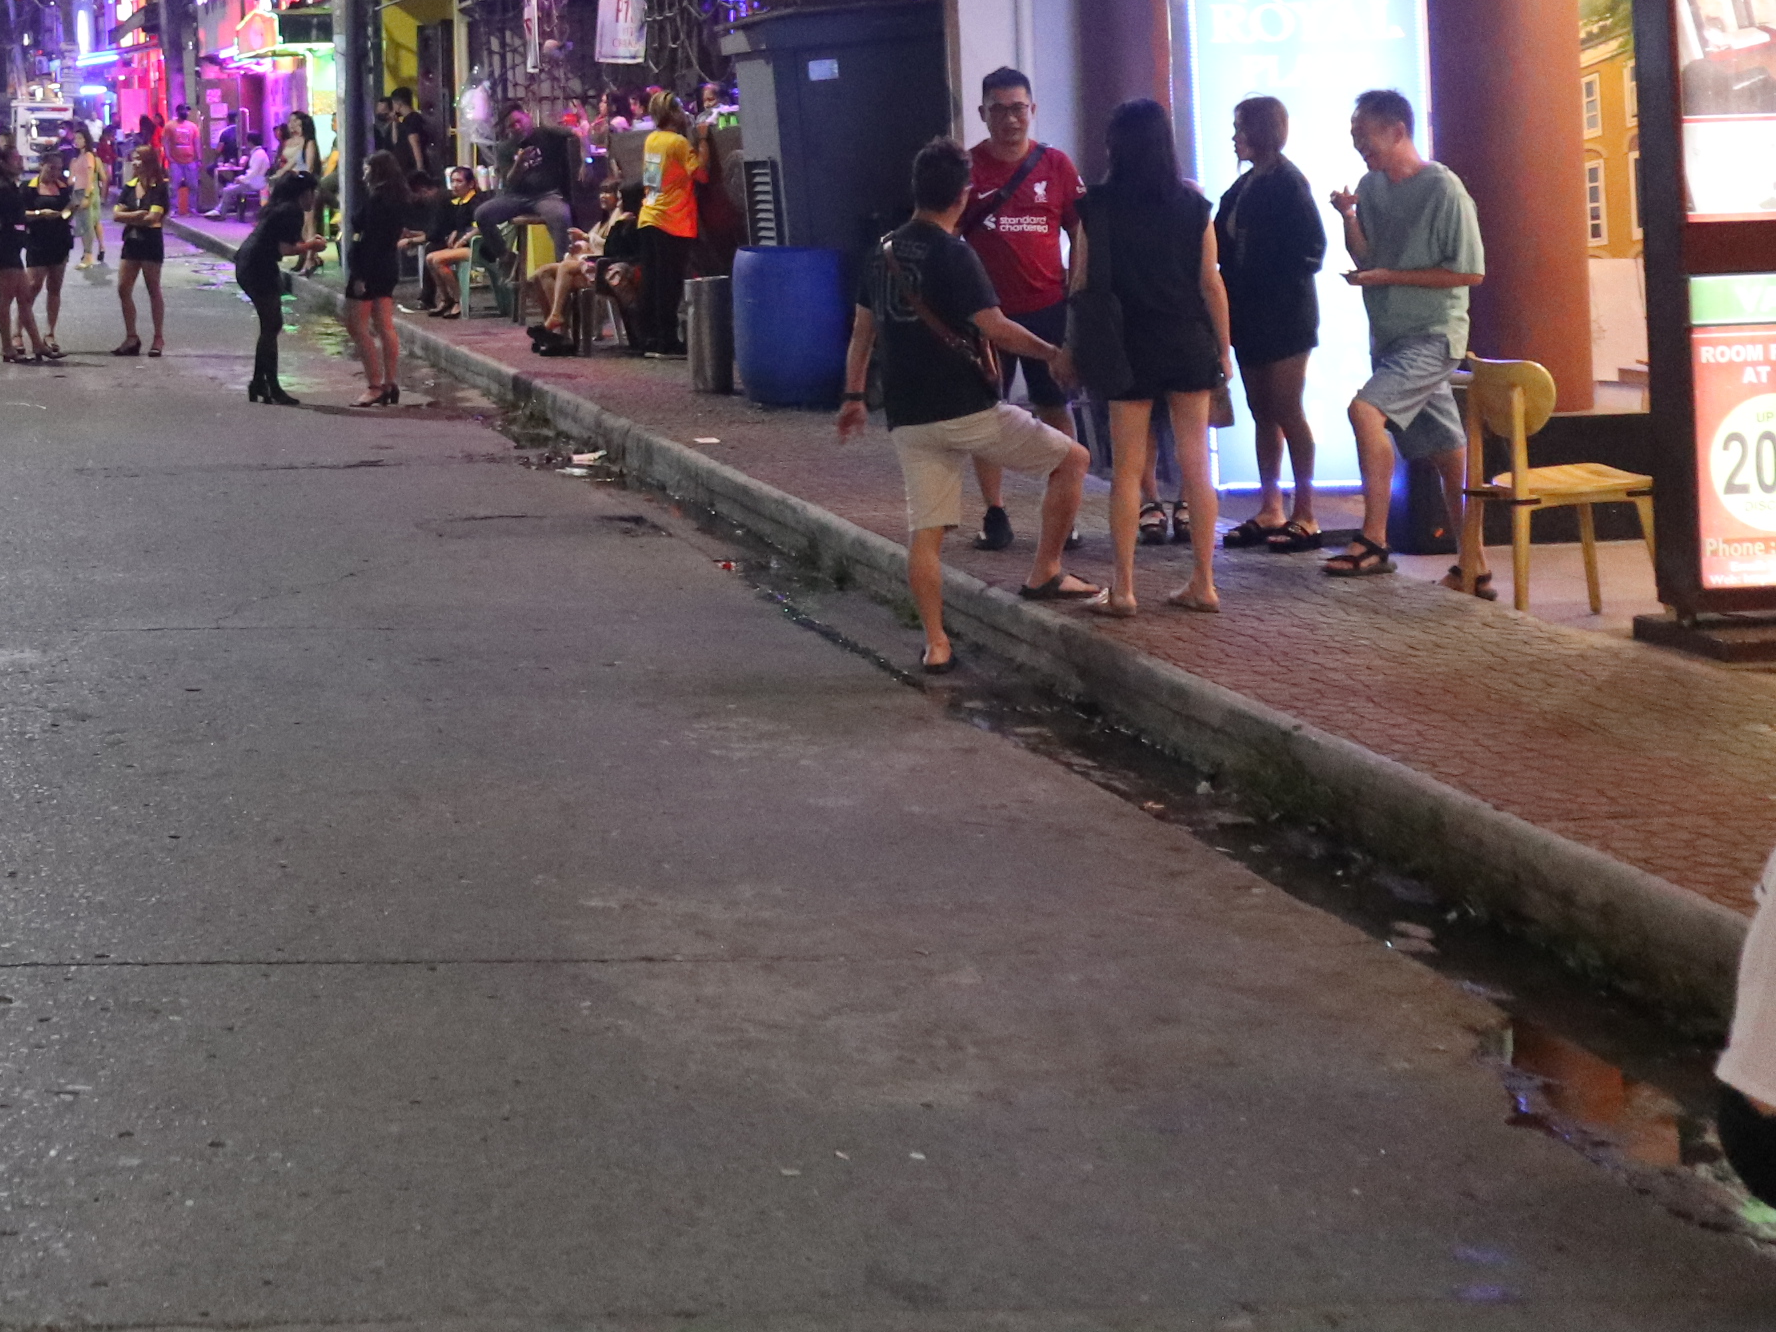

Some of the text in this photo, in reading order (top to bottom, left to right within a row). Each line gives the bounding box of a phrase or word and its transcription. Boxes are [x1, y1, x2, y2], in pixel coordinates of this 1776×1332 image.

[1210, 0, 1406, 45] ROYAL
[999, 215, 1047, 225] standard
[999, 223, 1049, 233] chartered
[1700, 343, 1764, 364] ROOM
[1742, 365, 1772, 384] AT
[1756, 411, 1775, 424] UP
[1705, 538, 1766, 557] Phone
